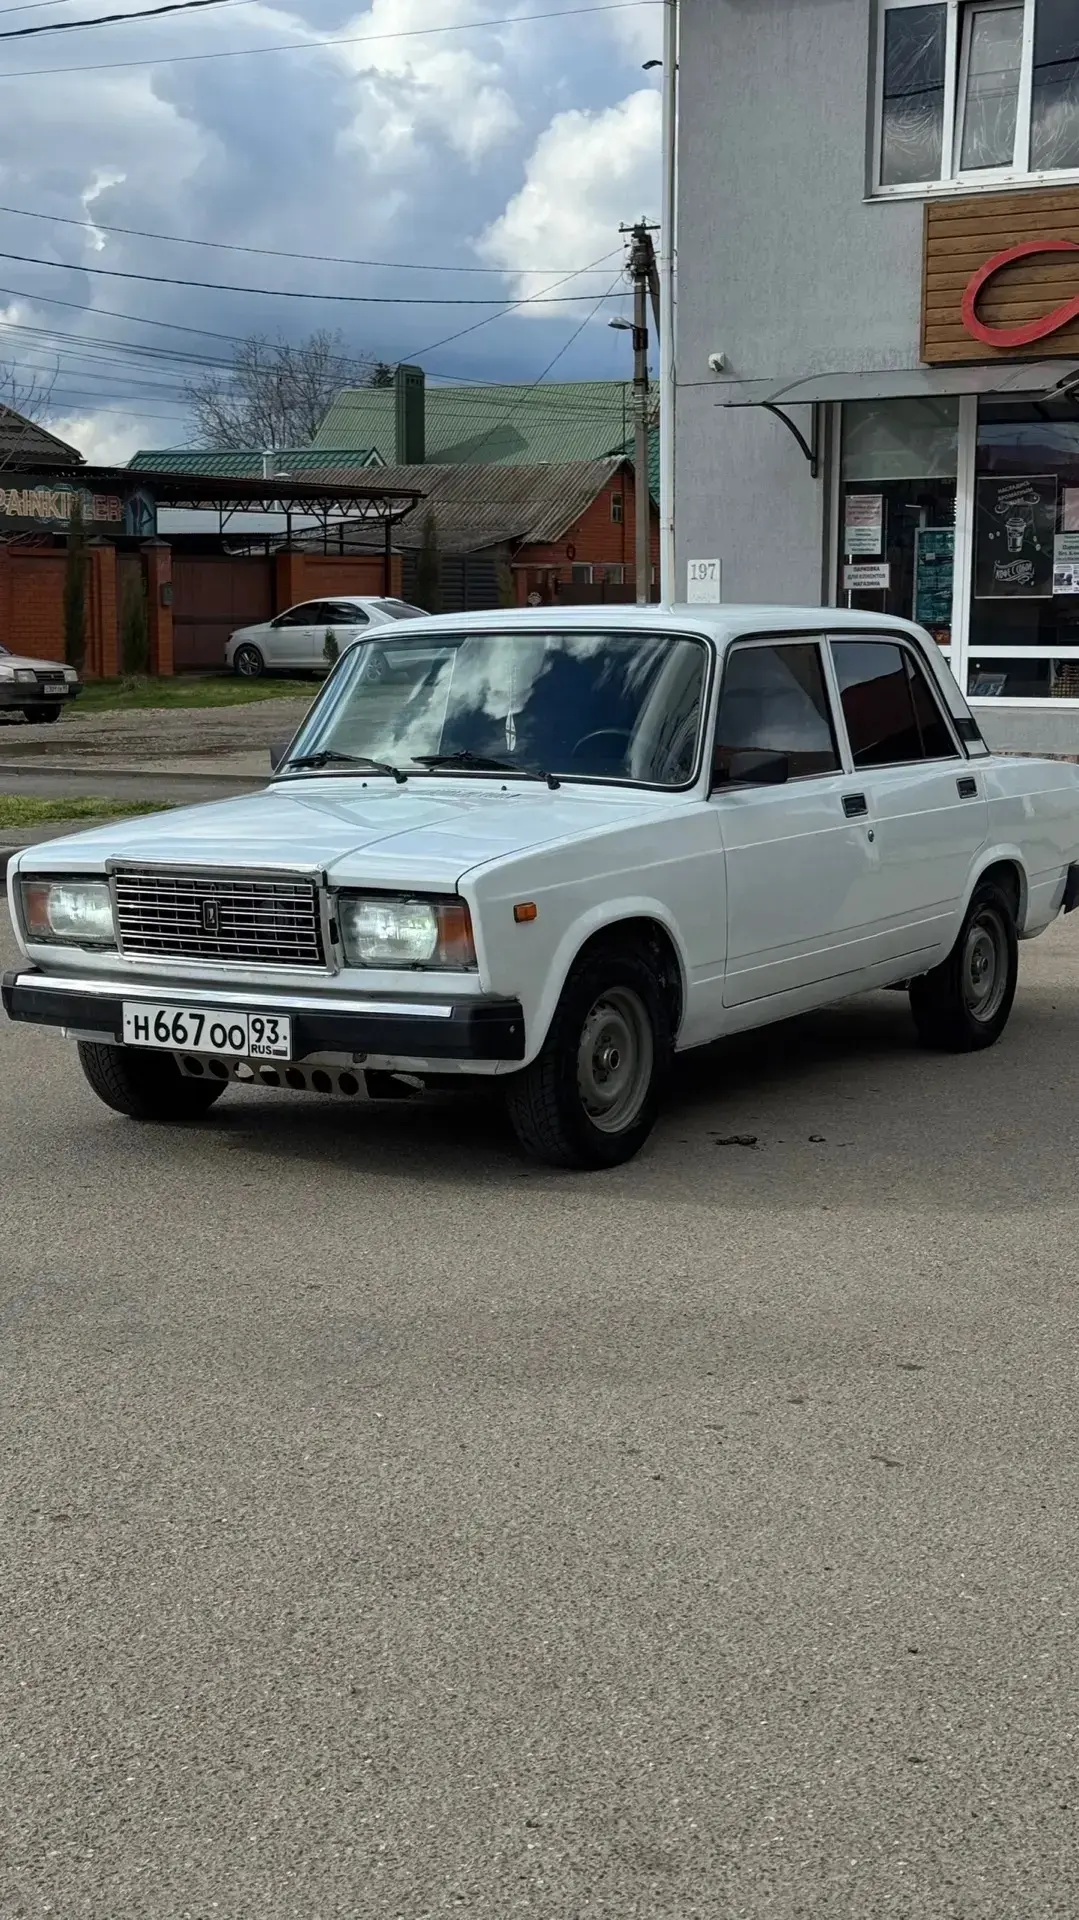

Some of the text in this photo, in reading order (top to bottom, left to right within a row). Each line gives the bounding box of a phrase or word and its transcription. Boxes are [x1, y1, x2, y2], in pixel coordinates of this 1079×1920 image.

[690, 563, 717, 580] 197
[251, 1017, 279, 1045] 93
[251, 1044, 272, 1055] RUS
